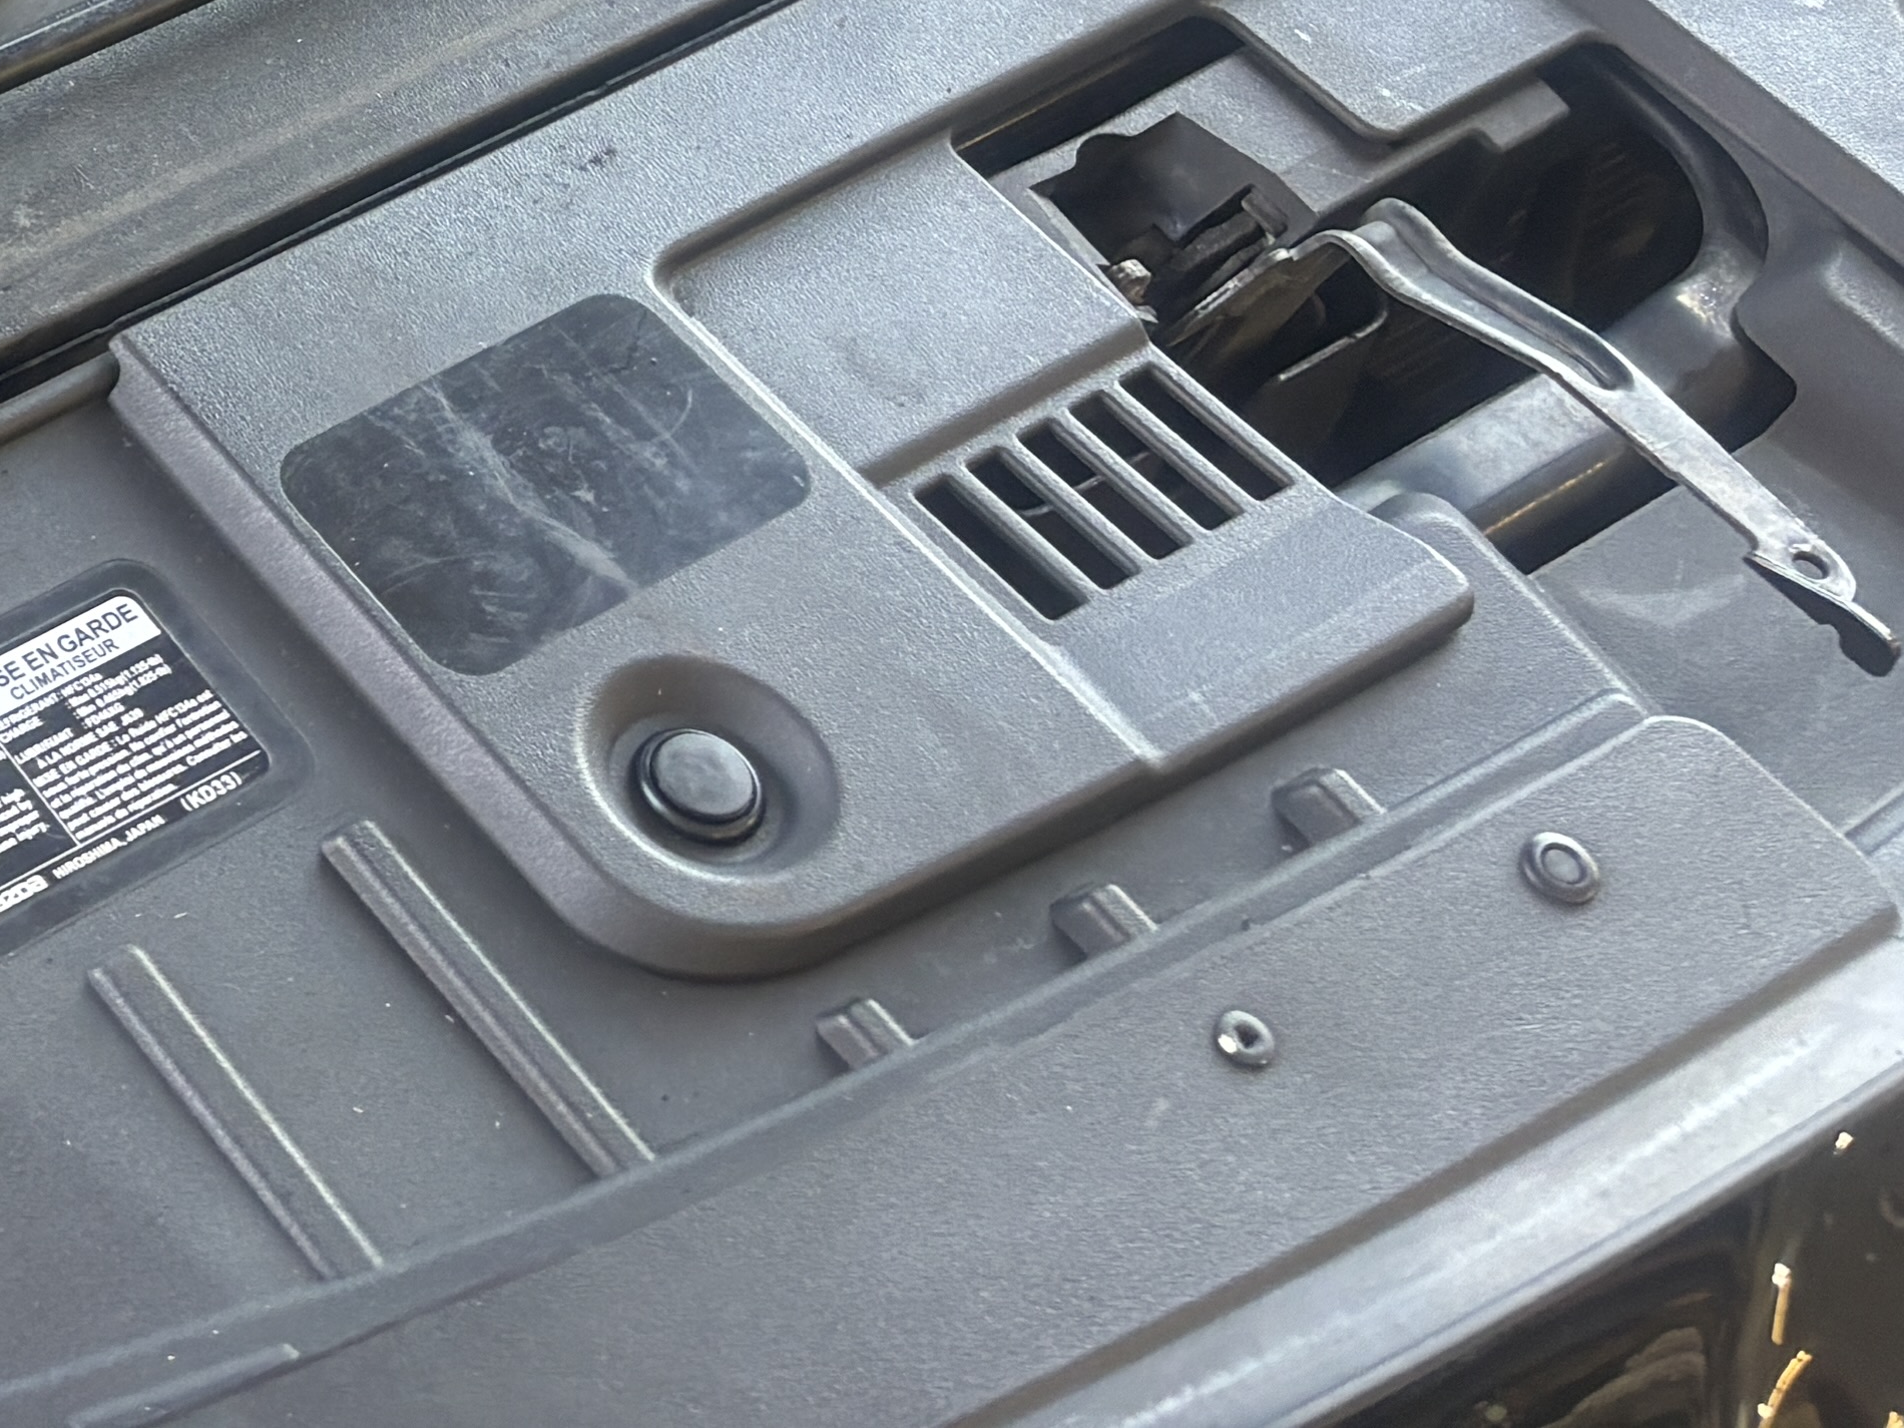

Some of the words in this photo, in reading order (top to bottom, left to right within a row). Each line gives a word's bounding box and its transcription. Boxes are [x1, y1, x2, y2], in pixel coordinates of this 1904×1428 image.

[11, 638, 119, 699] CLIMATISEUR
[22, 643, 58, 670] EN
[57, 603, 137, 652] GARDE
[125, 814, 165, 841] JAPAN
[180, 771, 242, 811] (KD33)
